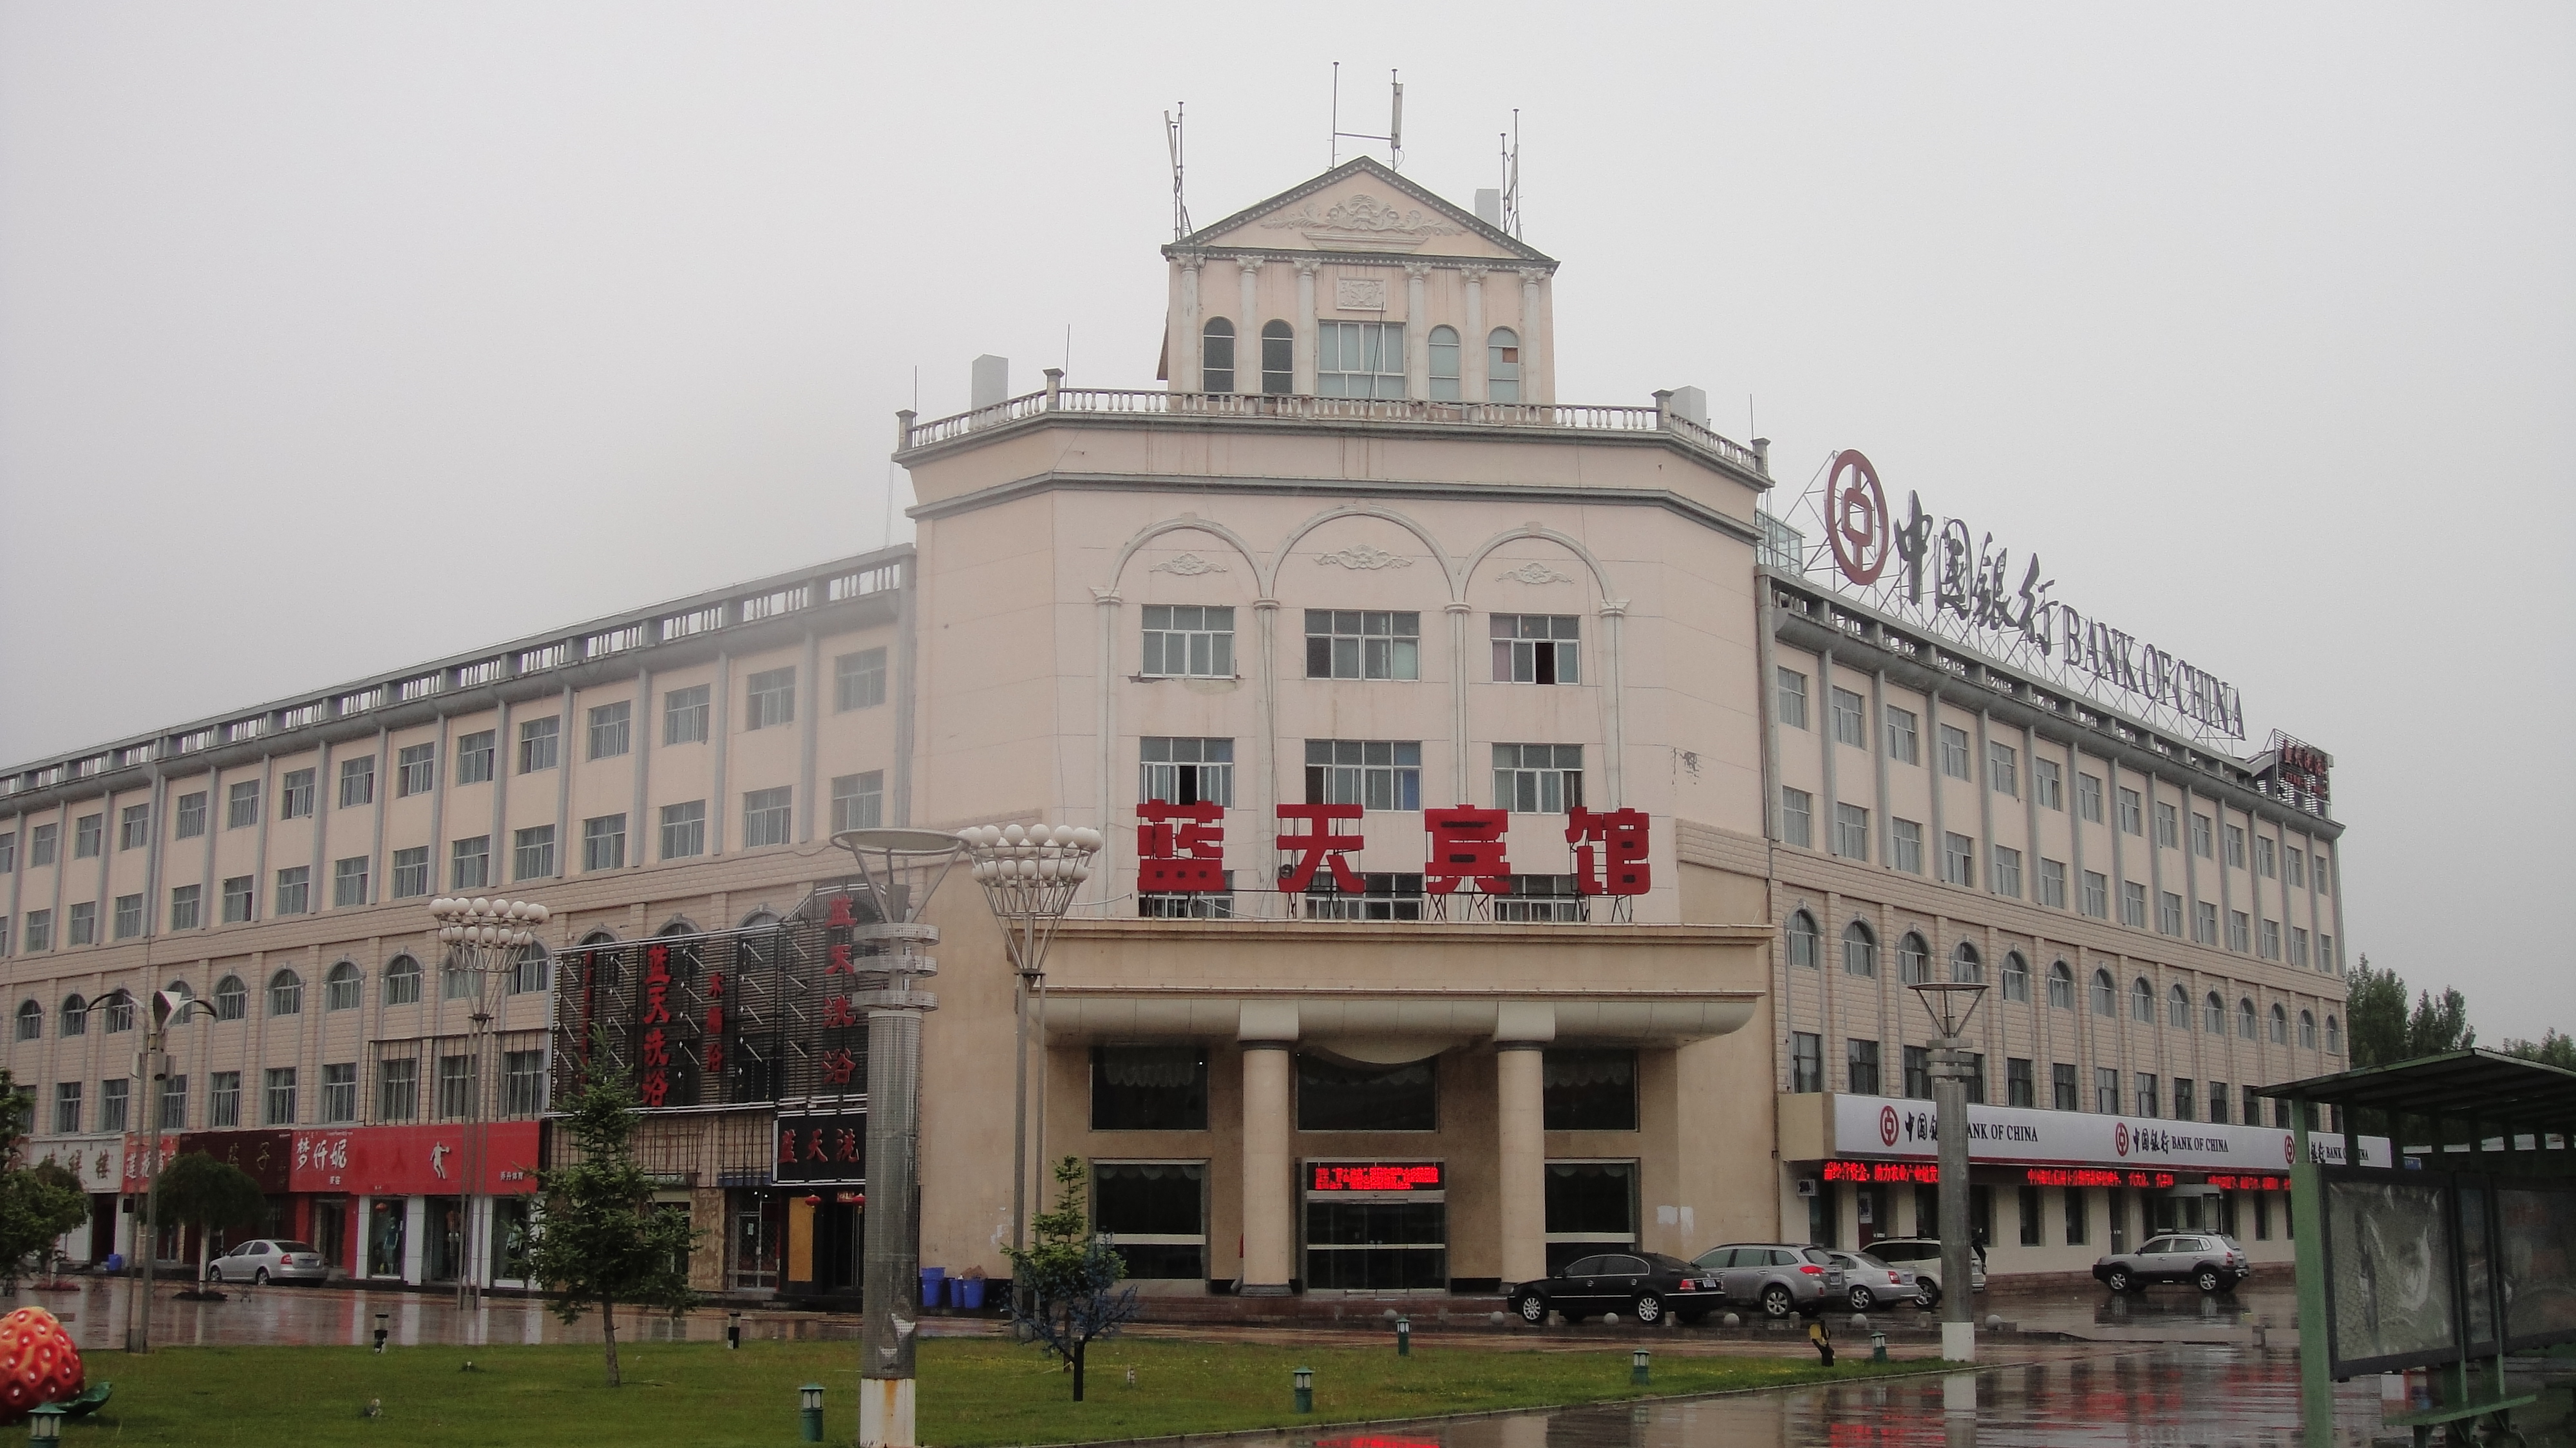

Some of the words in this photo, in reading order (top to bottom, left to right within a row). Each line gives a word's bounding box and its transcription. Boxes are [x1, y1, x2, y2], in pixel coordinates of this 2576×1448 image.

[1894, 490, 2059, 655] 中国银行
[2062, 604, 2136, 694] BANK
[2142, 643, 2172, 705] OF
[2174, 658, 2246, 740] CHINA
[1137, 799, 1651, 895] 蓝天宾馆
[822, 896, 857, 1085] 蓝天洗浴
[642, 945, 670, 1107] 蓝天洗浴
[1905, 1111, 1938, 1143] 中国银
[1967, 1123, 1989, 1139] ANK
[1991, 1125, 2004, 1140] OF
[2007, 1126, 2038, 1142] CHINA
[2133, 1127, 2170, 1154] 中国银行
[2172, 1136, 2193, 1150] BANK
[2194, 1138, 2204, 1151] OF
[2206, 1138, 2228, 1152] CHINA
[2326, 1147, 2342, 1159] BANK
